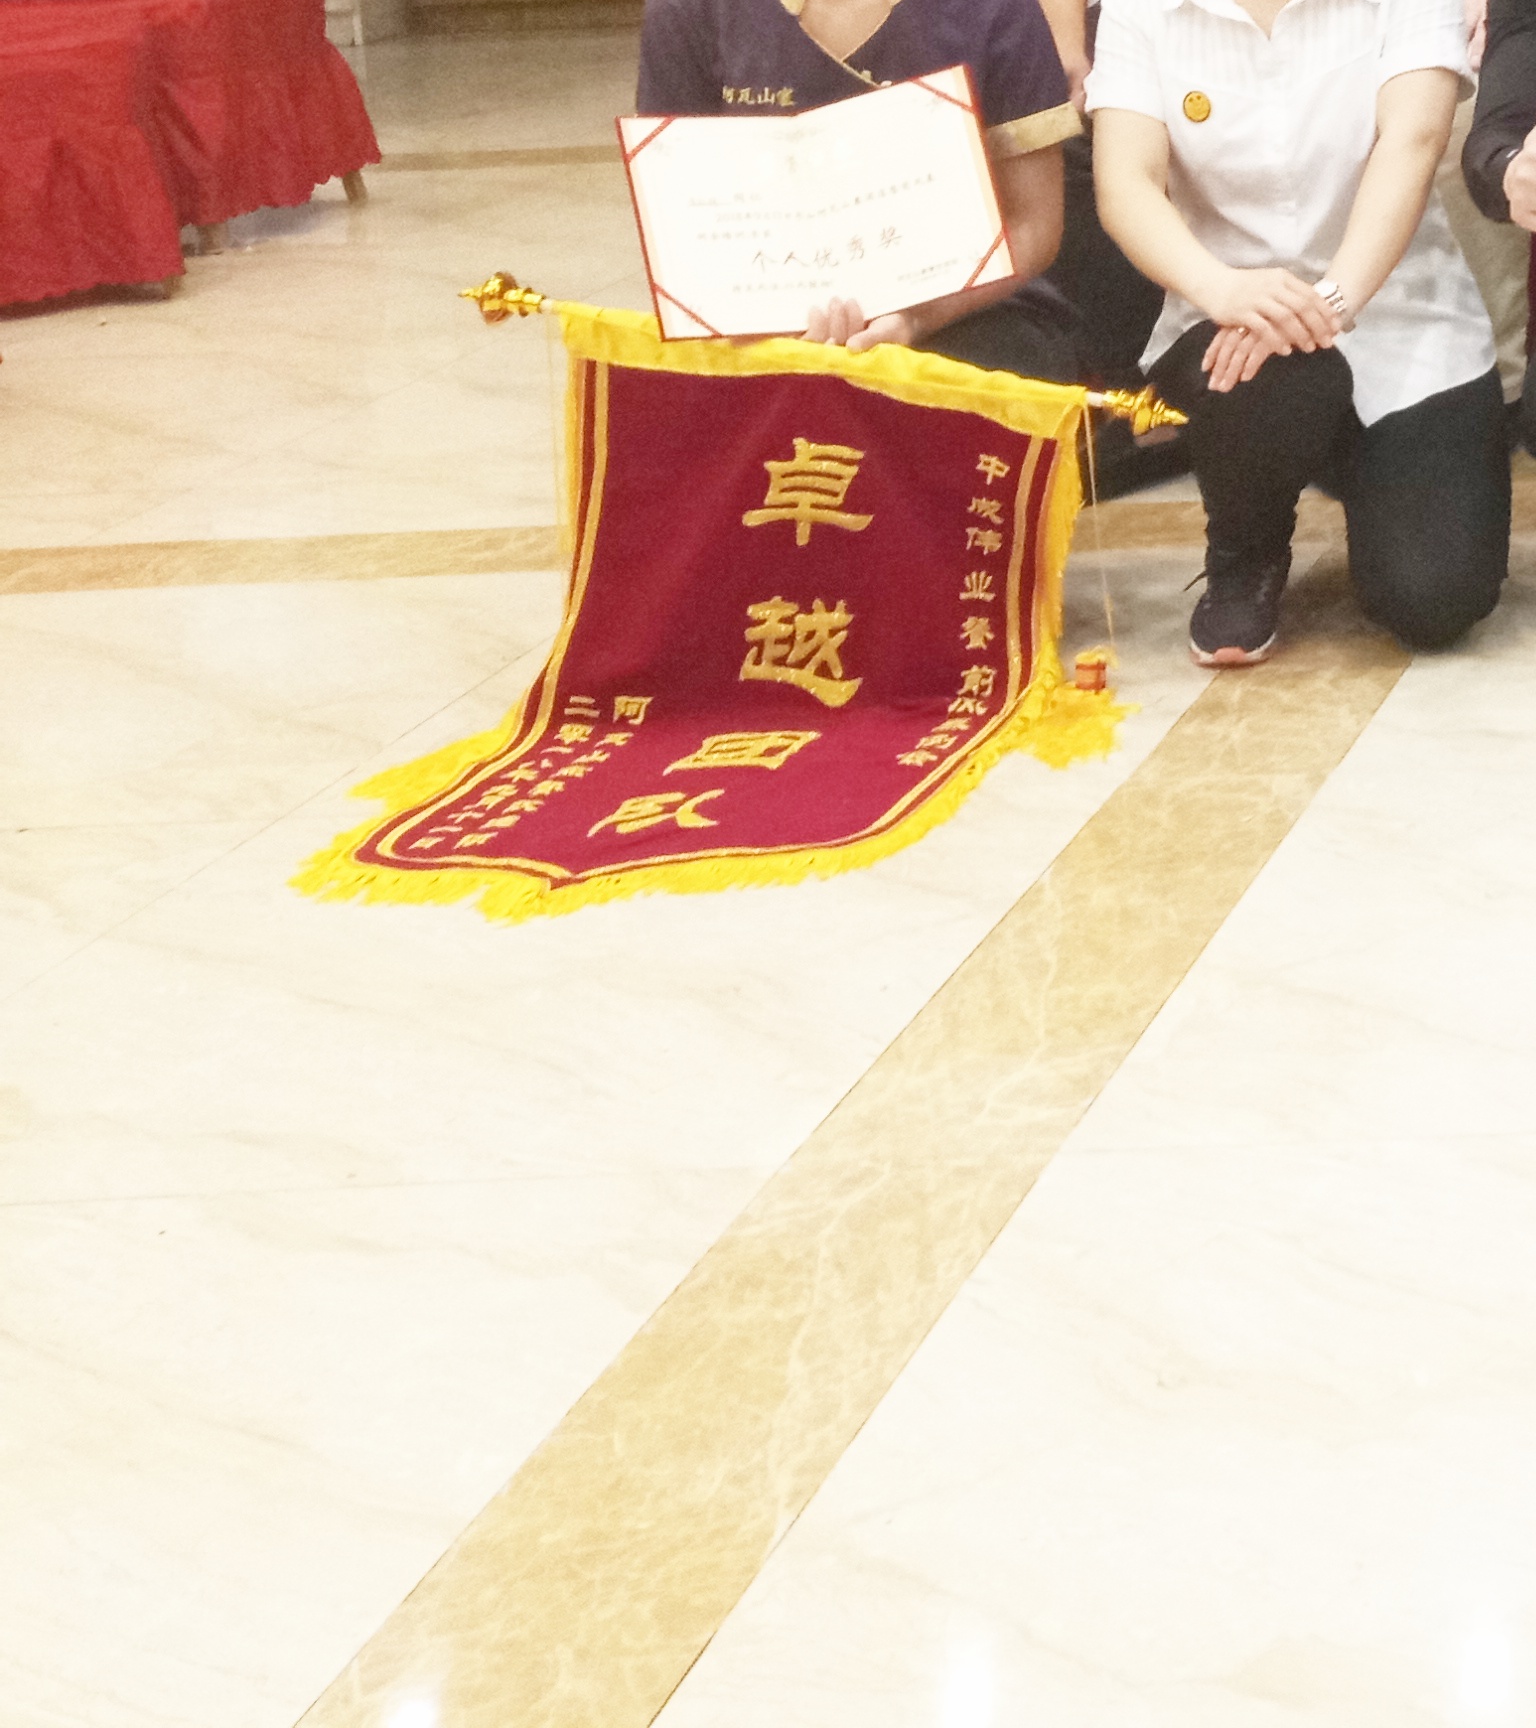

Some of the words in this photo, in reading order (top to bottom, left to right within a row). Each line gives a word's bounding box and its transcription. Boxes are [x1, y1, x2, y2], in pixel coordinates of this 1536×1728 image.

[752, 225, 904, 272] 个人优秀奖
[587, 437, 875, 837] 卓越团队
